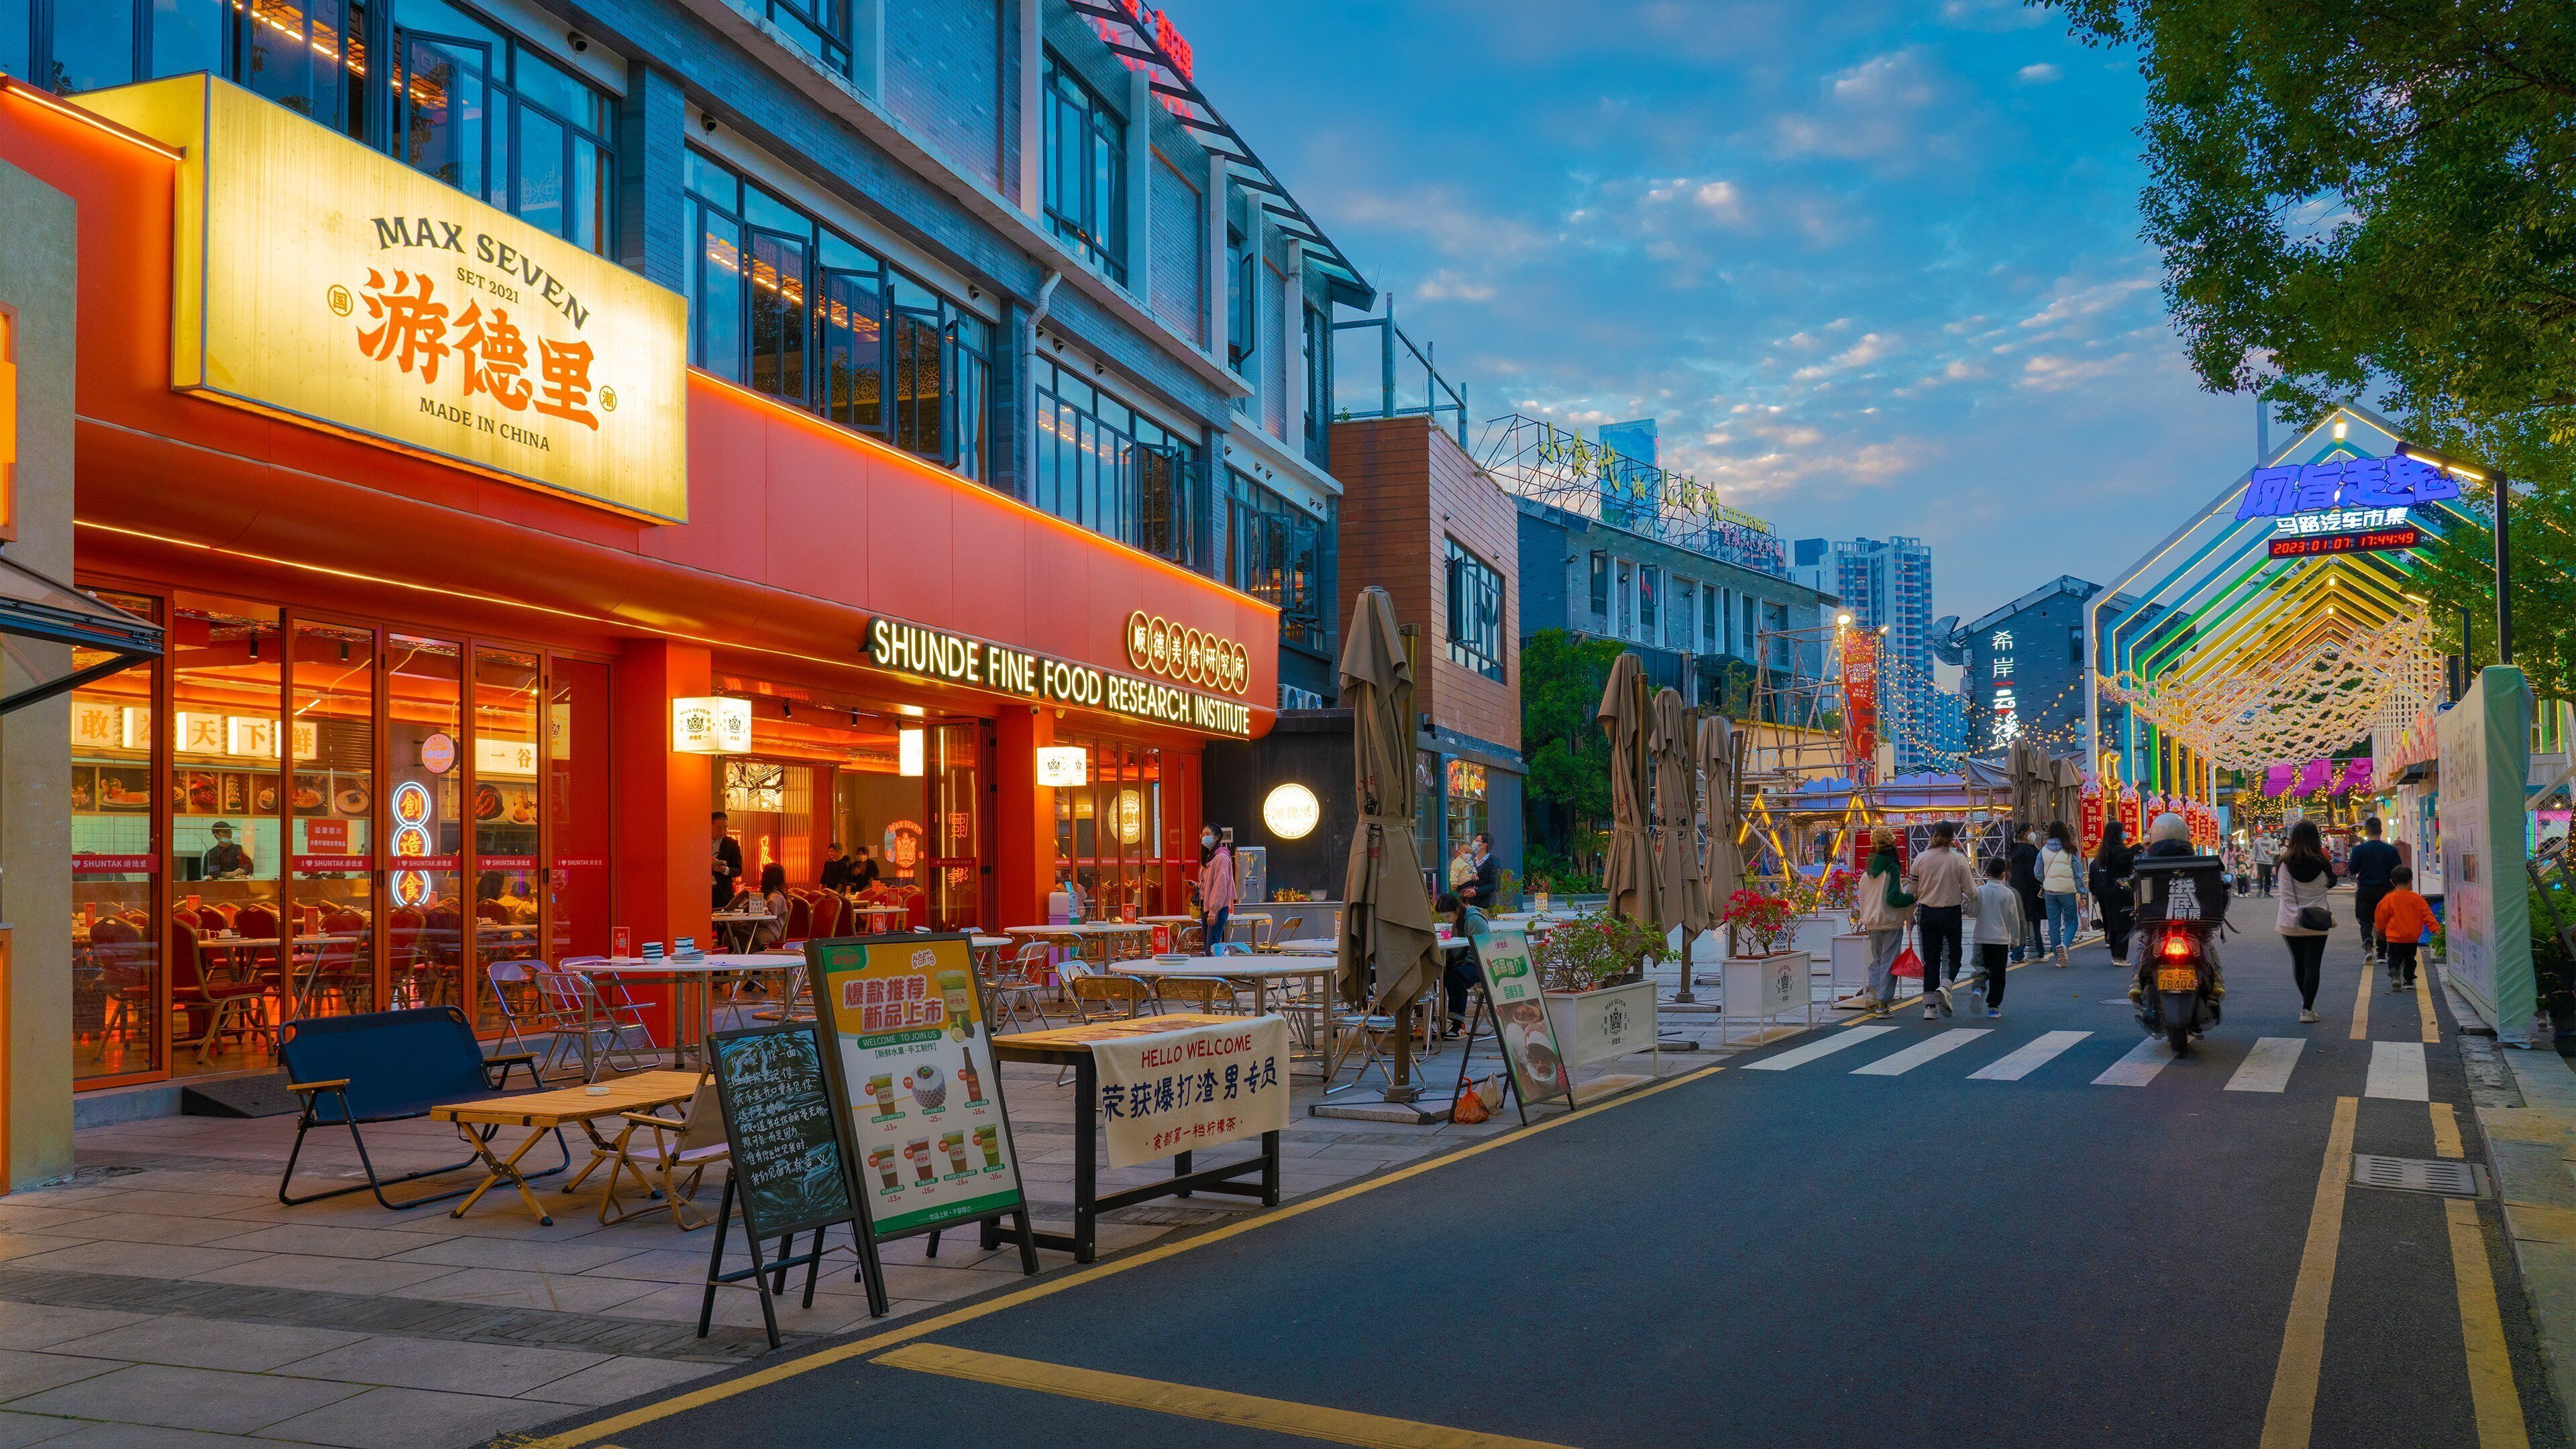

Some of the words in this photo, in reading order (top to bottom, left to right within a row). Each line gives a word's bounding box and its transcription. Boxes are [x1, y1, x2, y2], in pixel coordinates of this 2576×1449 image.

[370, 217, 465, 254] MAX
[476, 233, 591, 331] SEVEN
[457, 266, 484, 289] SET
[488, 280, 519, 304] 2021
[356, 267, 600, 431] 游德里
[419, 397, 472, 427] MADE
[477, 415, 495, 436] IN
[500, 423, 551, 452] CHINA
[1538, 421, 1621, 492] 小食代
[1658, 468, 1723, 525] 儿时味
[2275, 507, 2408, 535] 马路汽车市集
[2273, 542, 2306, 555] 2023
[2310, 540, 2328, 551] 01
[2332, 537, 2350, 550] 07
[2360, 531, 2415, 546] 17:44:49
[1133, 625, 1245, 682] 顺德美食研究所
[1992, 630, 2015, 679] 希岸
[874, 619, 979, 682] SHUNDE
[988, 647, 1035, 693] FINE
[1043, 660, 1102, 706] FOOD
[1108, 675, 1190, 723] RESEARCH
[1195, 695, 1250, 735] INSTITUTE
[83, 859, 123, 868] SHUNTAK
[2174, 908, 2201, 920] 厨房
[1491, 958, 1523, 977] 新品推介
[845, 977, 925, 1007] 爆款推荐
[863, 999, 943, 1030] 新品上市
[863, 1036, 896, 1047] WELCOME
[911, 1032, 927, 1042] JOIN
[928, 1030, 937, 1038] US
[1141, 1045, 1183, 1069] HELLO
[1187, 1033, 1252, 1059] WELCOME
[1102, 1055, 1279, 1122] 荣获爆打渣男专员
